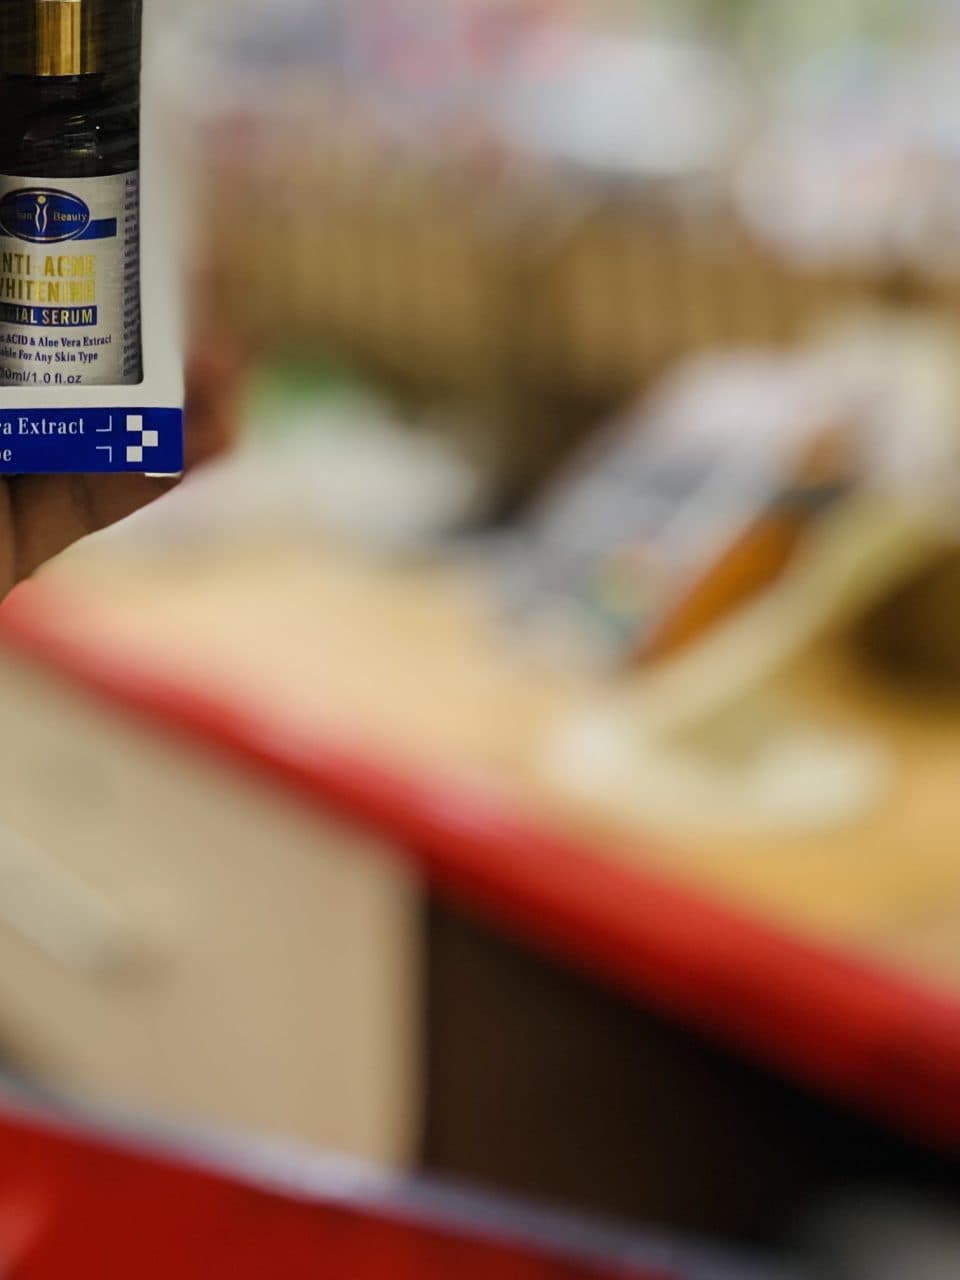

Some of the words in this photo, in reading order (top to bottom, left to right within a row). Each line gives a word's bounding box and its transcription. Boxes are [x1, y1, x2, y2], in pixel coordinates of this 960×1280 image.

[54, 209, 88, 223] Beauty
[42, 309, 93, 326] SERUM
[6, 334, 28, 346] ACID
[38, 336, 60, 348] Aloe
[61, 337, 82, 349] Vera
[83, 334, 113, 347] Extract
[18, 350, 33, 362] For
[35, 351, 53, 365] Any
[55, 351, 76, 363] Skin
[78, 351, 98, 364] Type
[18, 416, 85, 436] Extract
